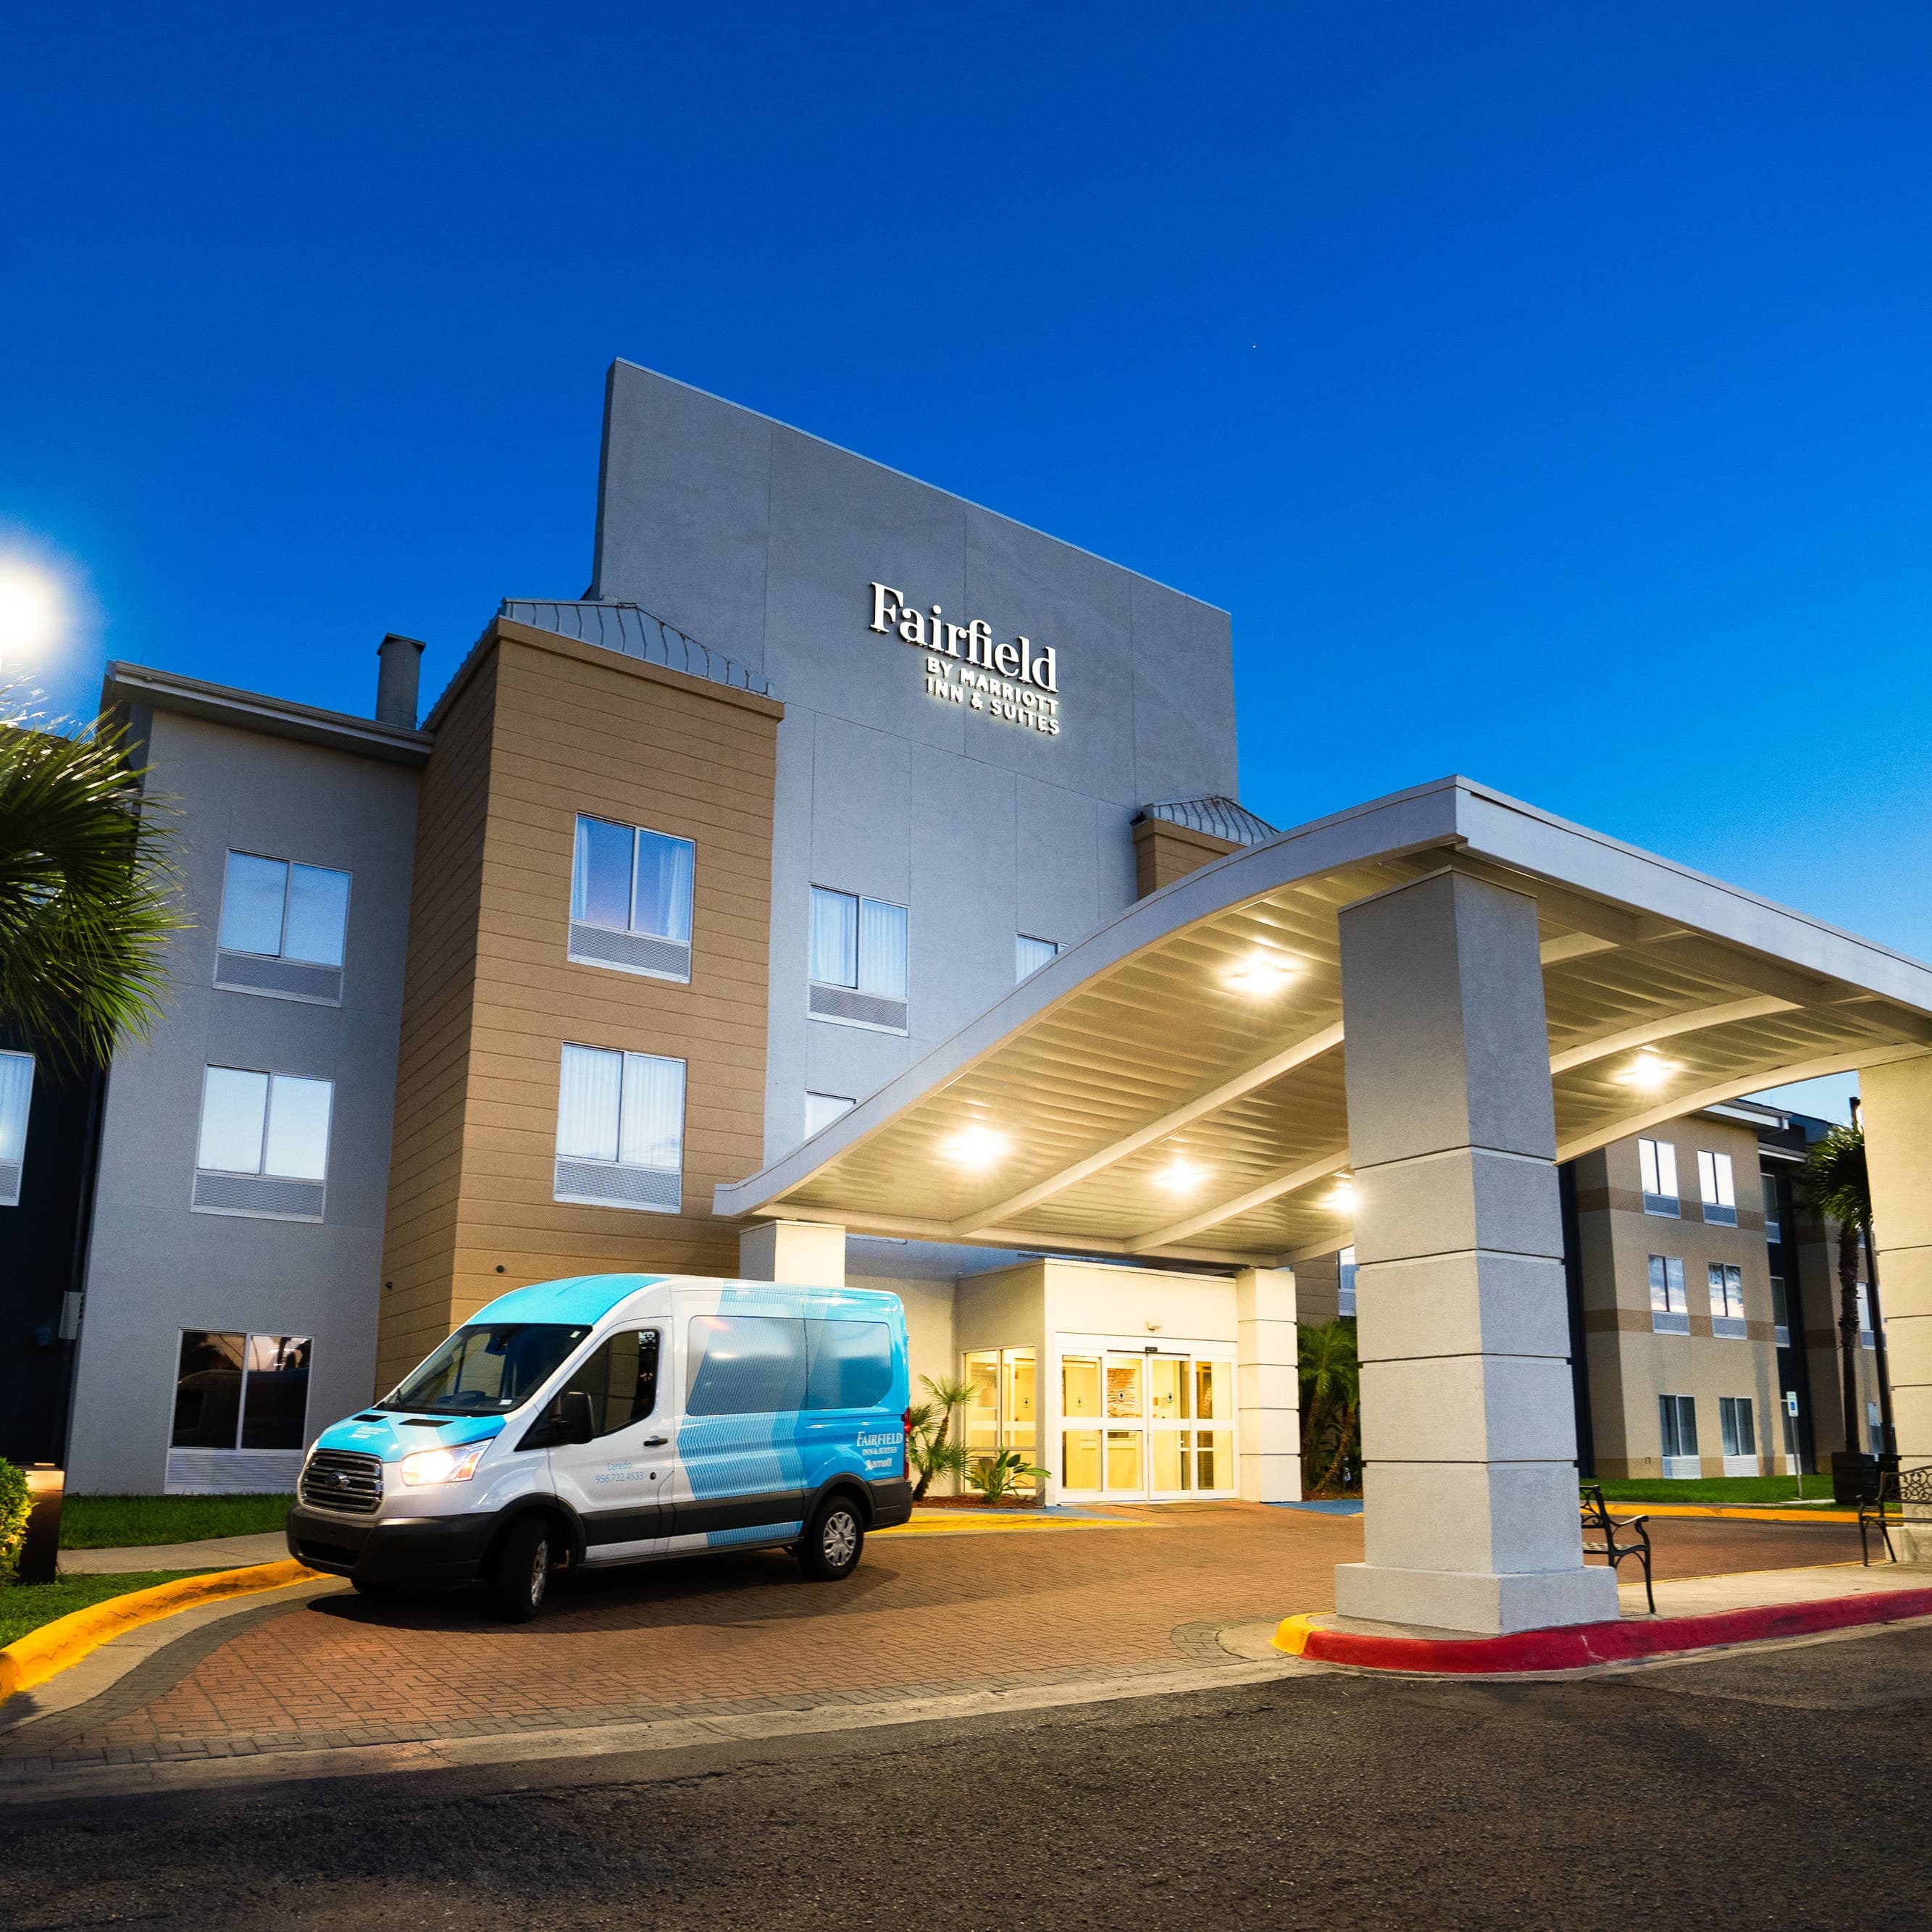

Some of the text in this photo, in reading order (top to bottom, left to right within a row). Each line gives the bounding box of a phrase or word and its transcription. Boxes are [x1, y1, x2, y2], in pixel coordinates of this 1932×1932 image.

[870, 582, 1059, 693] Fairfield
[927, 656, 1059, 715] BY MARRIOTT
[927, 677, 1060, 735] INN & SUITES
[856, 1431, 903, 1447] FAIRFIELD
